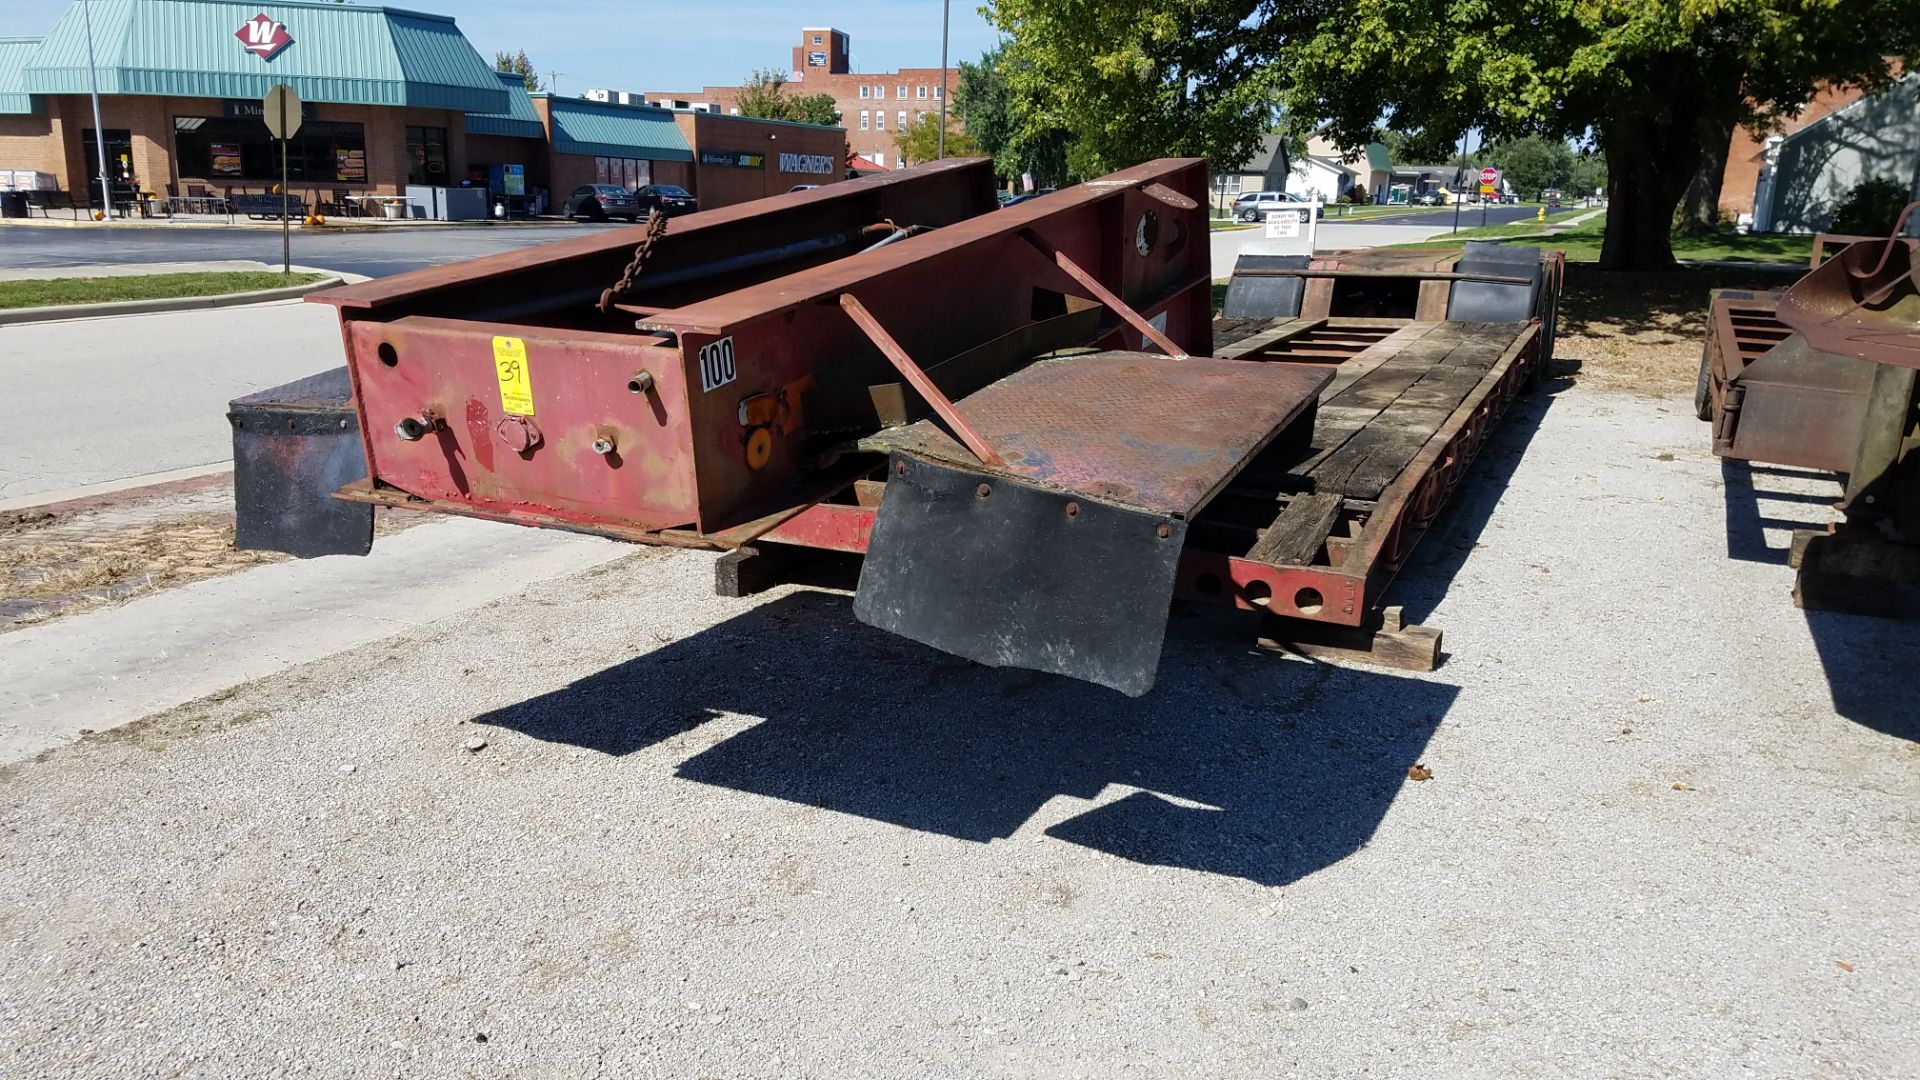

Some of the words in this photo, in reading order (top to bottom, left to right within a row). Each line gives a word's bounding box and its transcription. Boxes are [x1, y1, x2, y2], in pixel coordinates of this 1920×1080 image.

[246, 20, 281, 44] W
[779, 153, 834, 174] WAGNER'S
[500, 360, 521, 384] 39
[701, 339, 735, 388] 100
